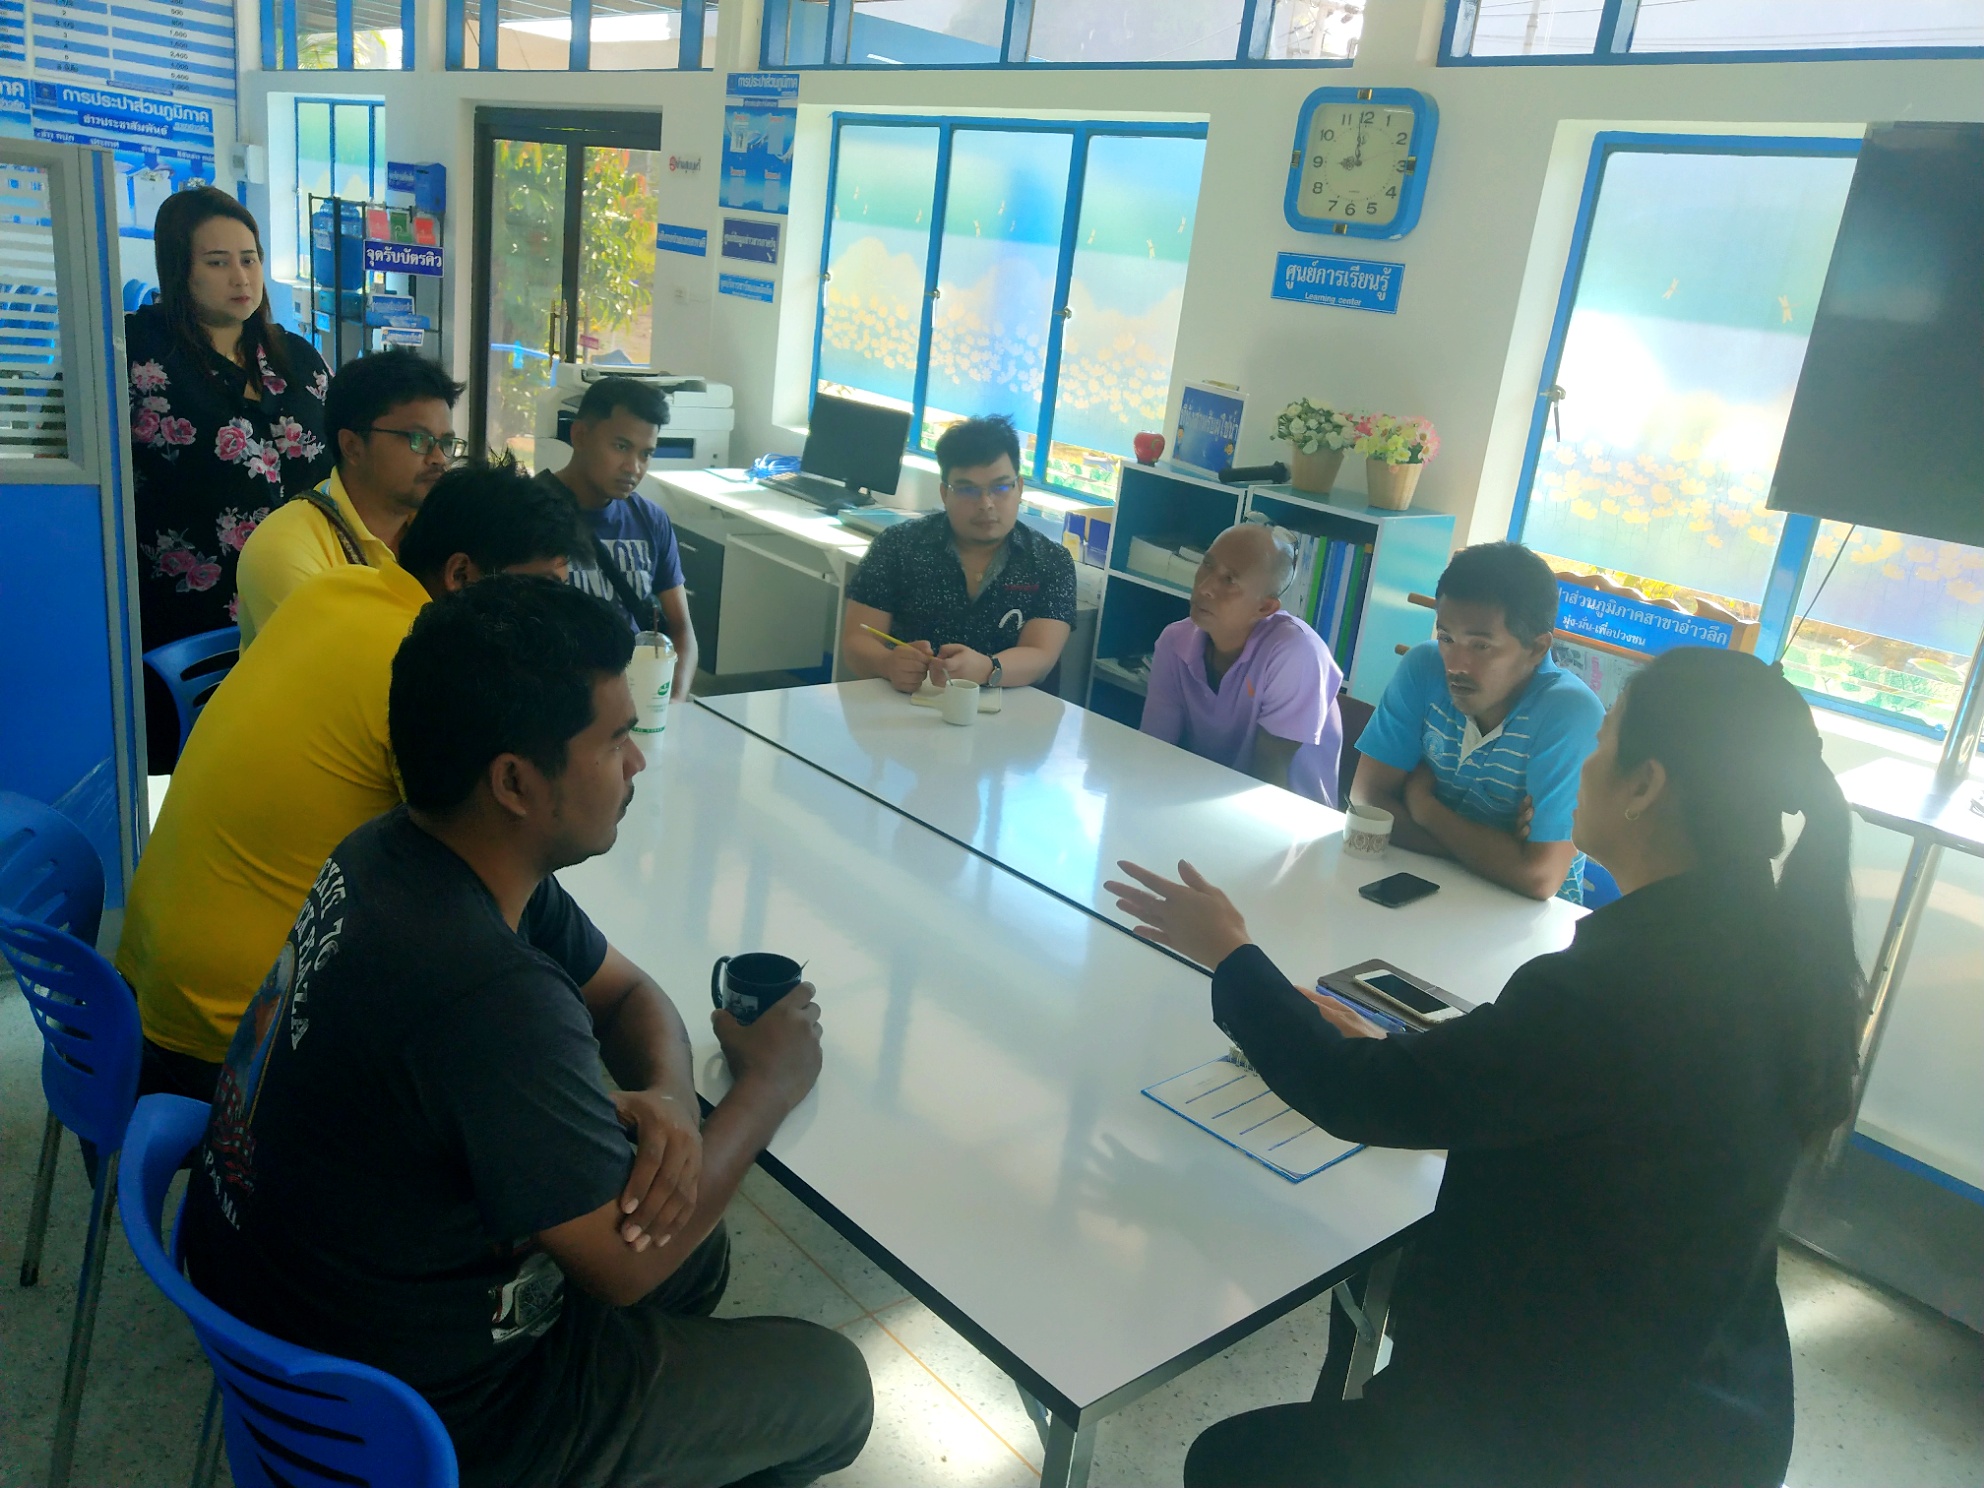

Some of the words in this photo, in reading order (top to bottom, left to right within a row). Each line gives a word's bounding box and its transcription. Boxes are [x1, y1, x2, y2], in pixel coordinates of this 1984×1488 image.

[62, 88, 210, 124] การประปาส่วนภูมิภาค
[1341, 113, 1352, 126] 11
[1360, 111, 1375, 125] 12
[1385, 114, 1392, 127] 1
[1320, 128, 1335, 142] 10
[1396, 132, 1408, 146] 2
[1312, 155, 1324, 168] 9
[1312, 181, 1323, 195] 8
[1385, 186, 1397, 199] 4
[1328, 200, 1338, 213] 7
[1345, 203, 1356, 216] 6
[1366, 202, 1378, 215] 5
[366, 246, 443, 267] จุดรับบัตรคิว
[1285, 260, 1392, 301] ศูนย์การเรียนรู้
[1305, 291, 1336, 304] Learning
[1338, 295, 1362, 306] center
